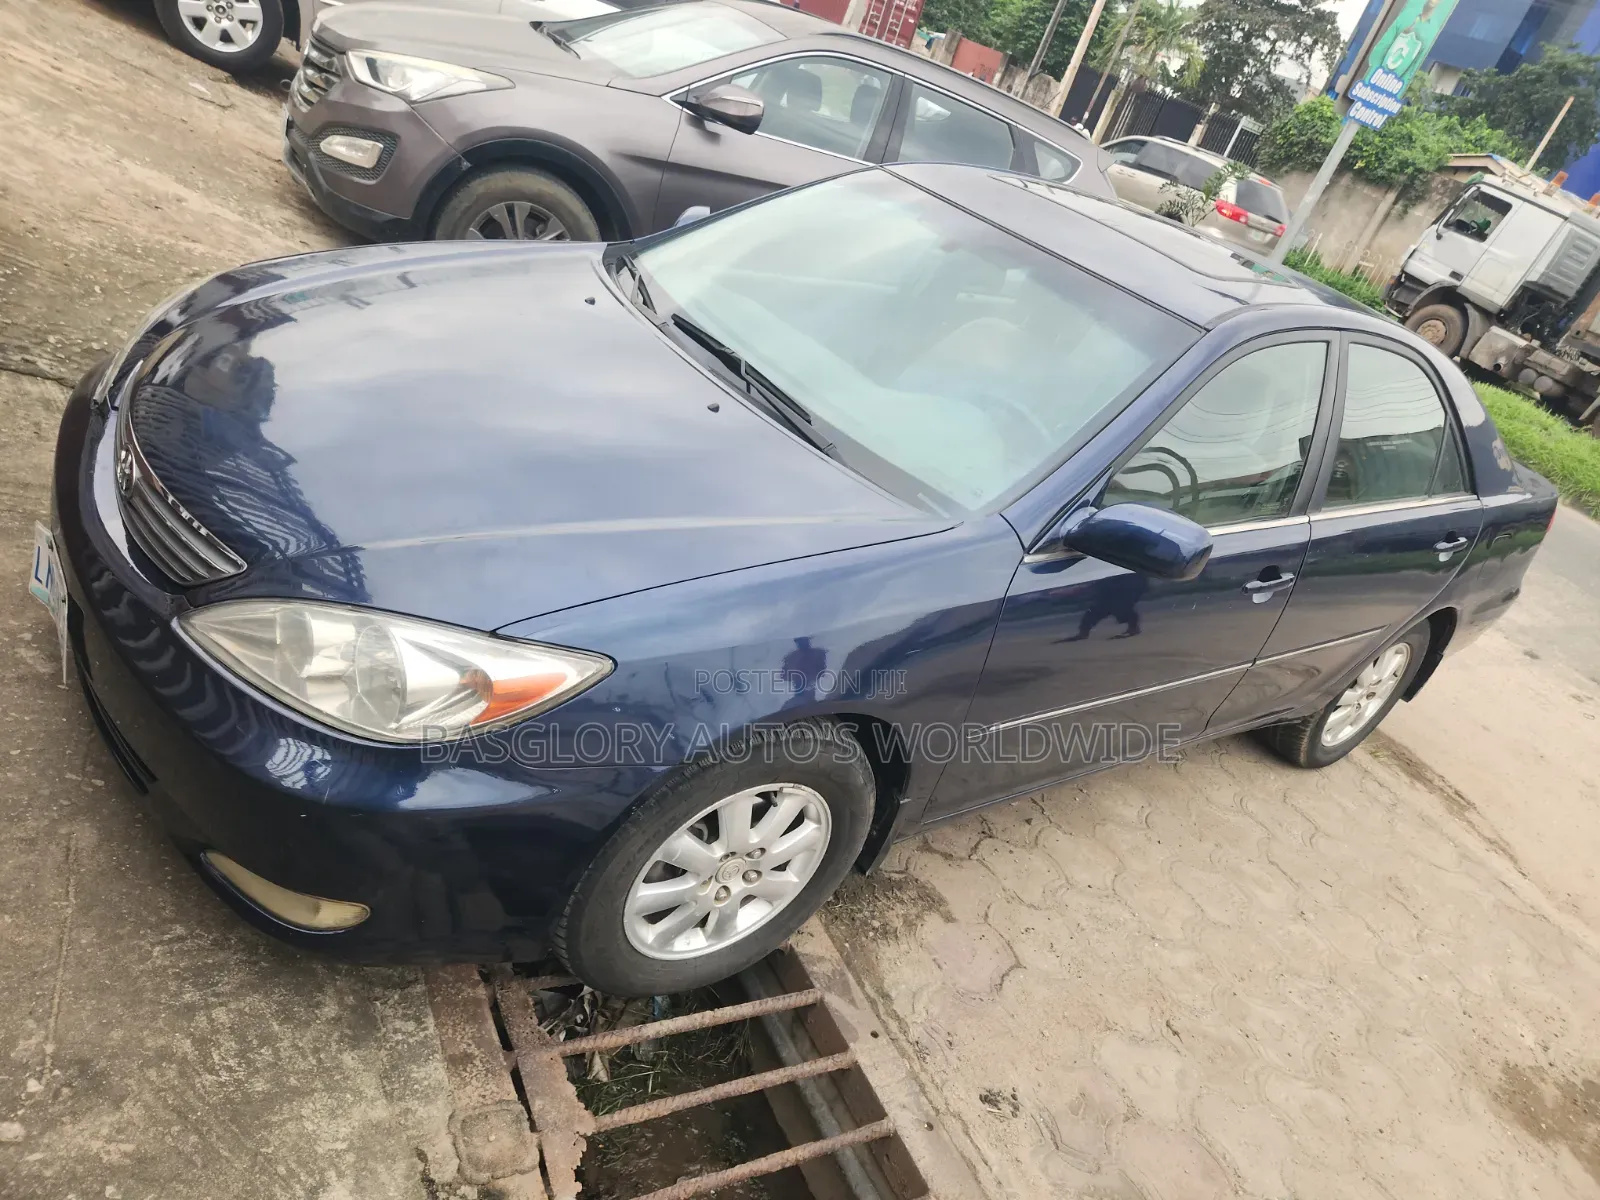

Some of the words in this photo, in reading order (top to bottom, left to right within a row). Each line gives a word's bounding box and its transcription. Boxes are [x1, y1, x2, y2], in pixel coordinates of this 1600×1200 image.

[1370, 68, 1403, 94] Online
[1351, 82, 1402, 115] Subscription
[1350, 101, 1388, 128] Control
